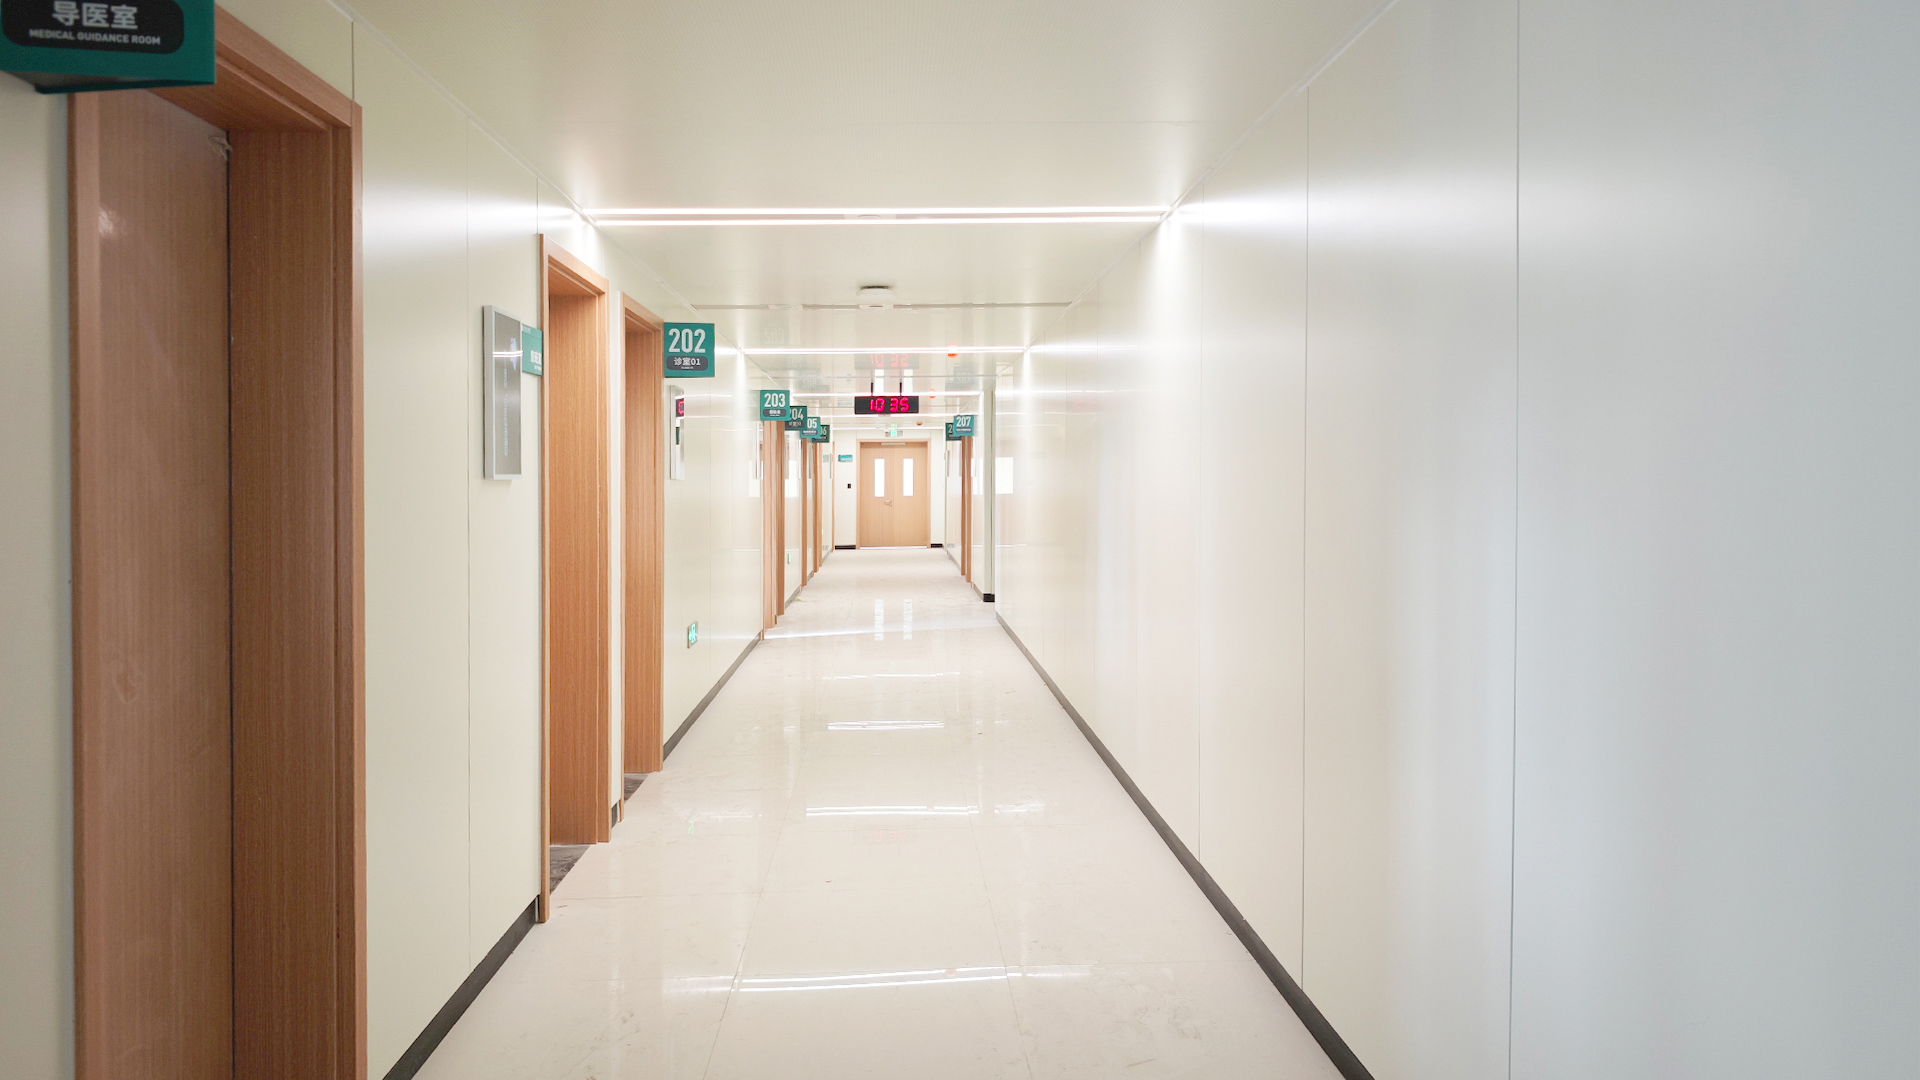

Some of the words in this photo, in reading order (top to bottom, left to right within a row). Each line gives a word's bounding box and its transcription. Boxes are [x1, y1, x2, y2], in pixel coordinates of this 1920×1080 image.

[52, 0, 139, 30] 导医室
[29, 28, 75, 41] MEDICAL
[77, 32, 130, 44] GUIDANCE
[131, 35, 161, 45] ROOM
[668, 328, 706, 353] 202
[674, 356, 702, 366] 诊室01
[764, 392, 786, 408] 203
[790, 408, 804, 420] 04
[956, 416, 972, 427] 207
